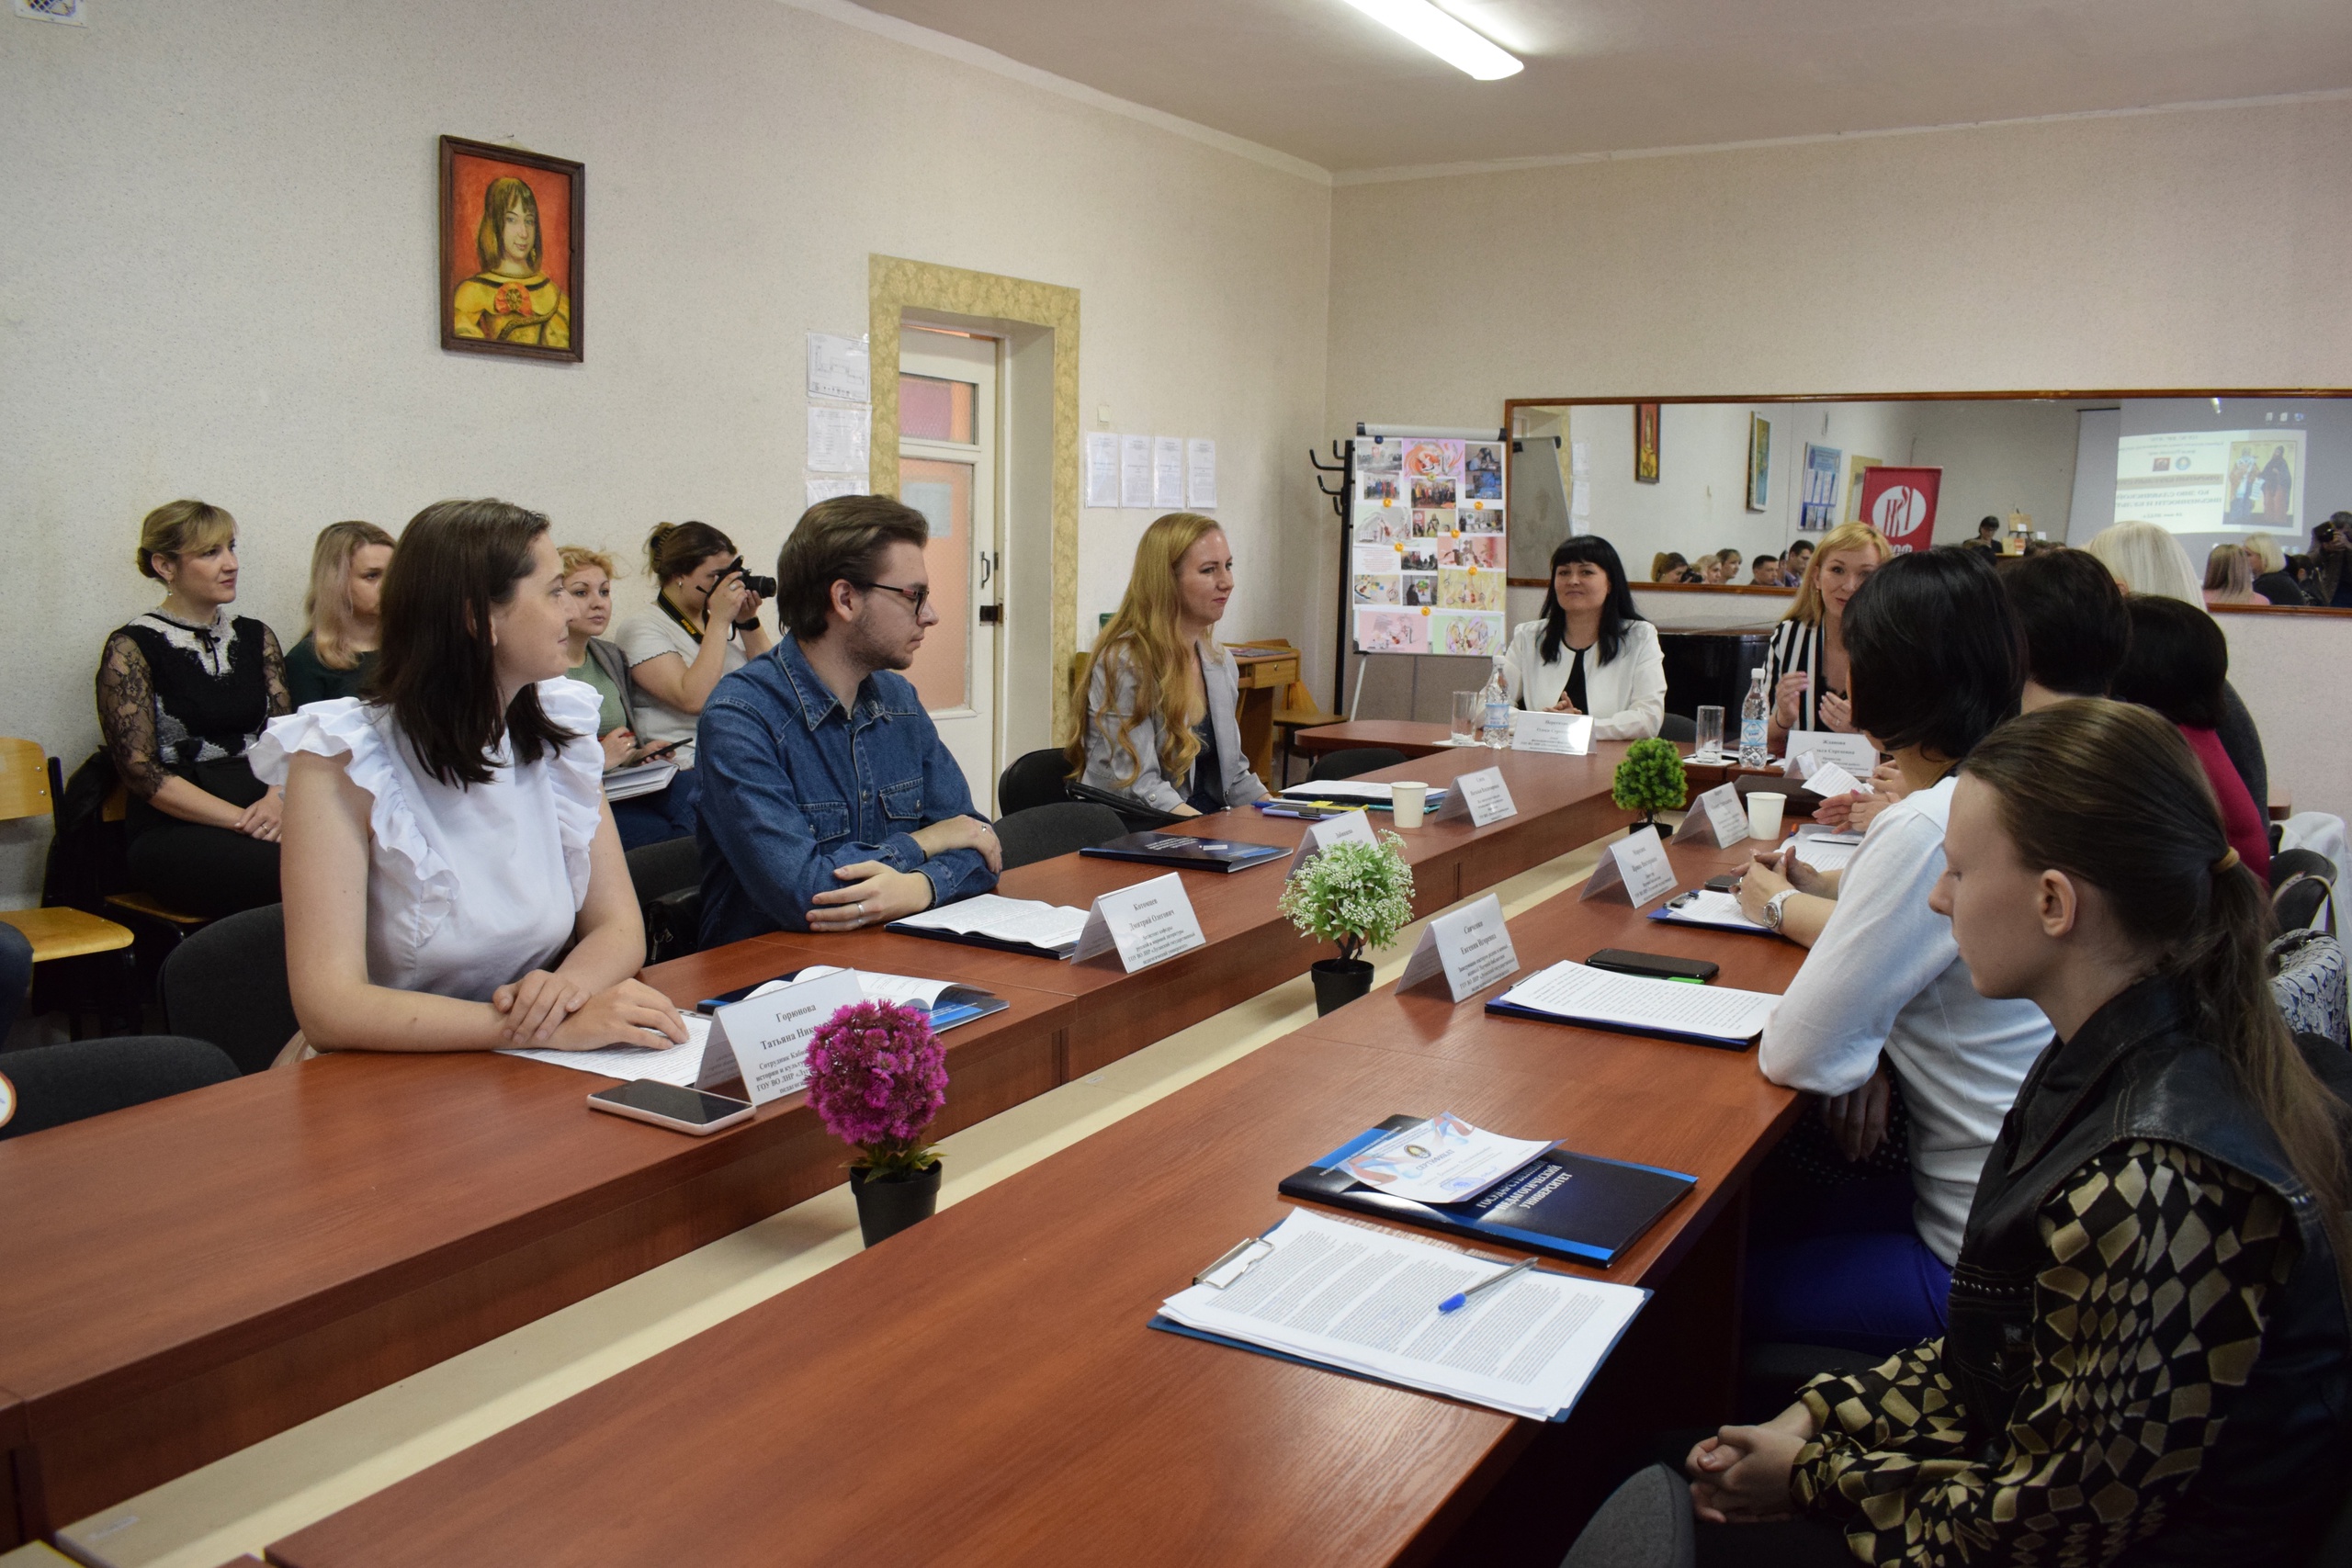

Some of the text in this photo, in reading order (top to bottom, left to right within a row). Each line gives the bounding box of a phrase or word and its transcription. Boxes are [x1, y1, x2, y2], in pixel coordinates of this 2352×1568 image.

[776, 1005, 816, 1022] Горюнова
[760, 1033, 796, 1050] Татьяна
[759, 1056, 789, 1069] Сотрудник
[782, 1073, 794, 1082] ЛНР
[1495, 1164, 1563, 1210] ПЕДАГОГИЧЕСКИЙ
[1519, 1172, 1573, 1209] УНИВЕРСИТЕТ
